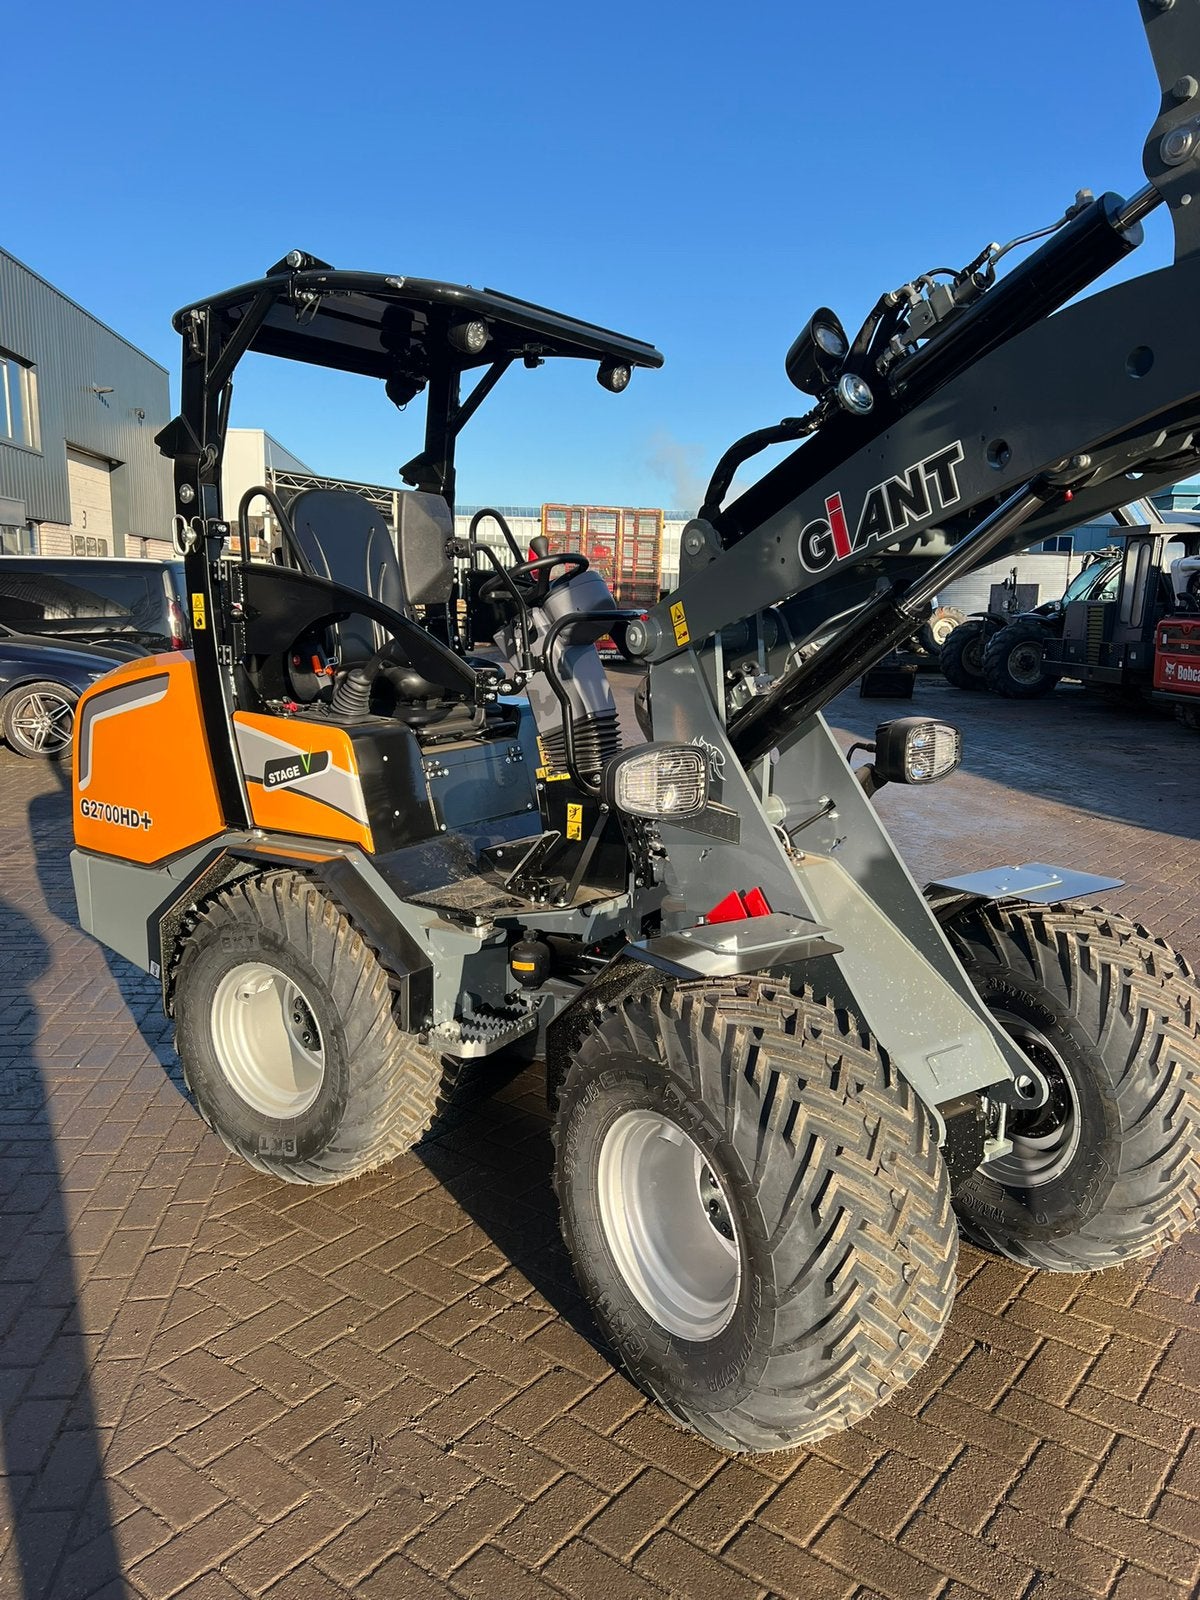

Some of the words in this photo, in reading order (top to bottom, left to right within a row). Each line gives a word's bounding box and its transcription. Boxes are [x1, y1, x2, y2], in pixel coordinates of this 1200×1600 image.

[82, 510, 87, 529] 3
[268, 765, 301, 784] STAGE
[80, 797, 153, 831] G2700HD+
[259, 1134, 297, 1157] BKT
